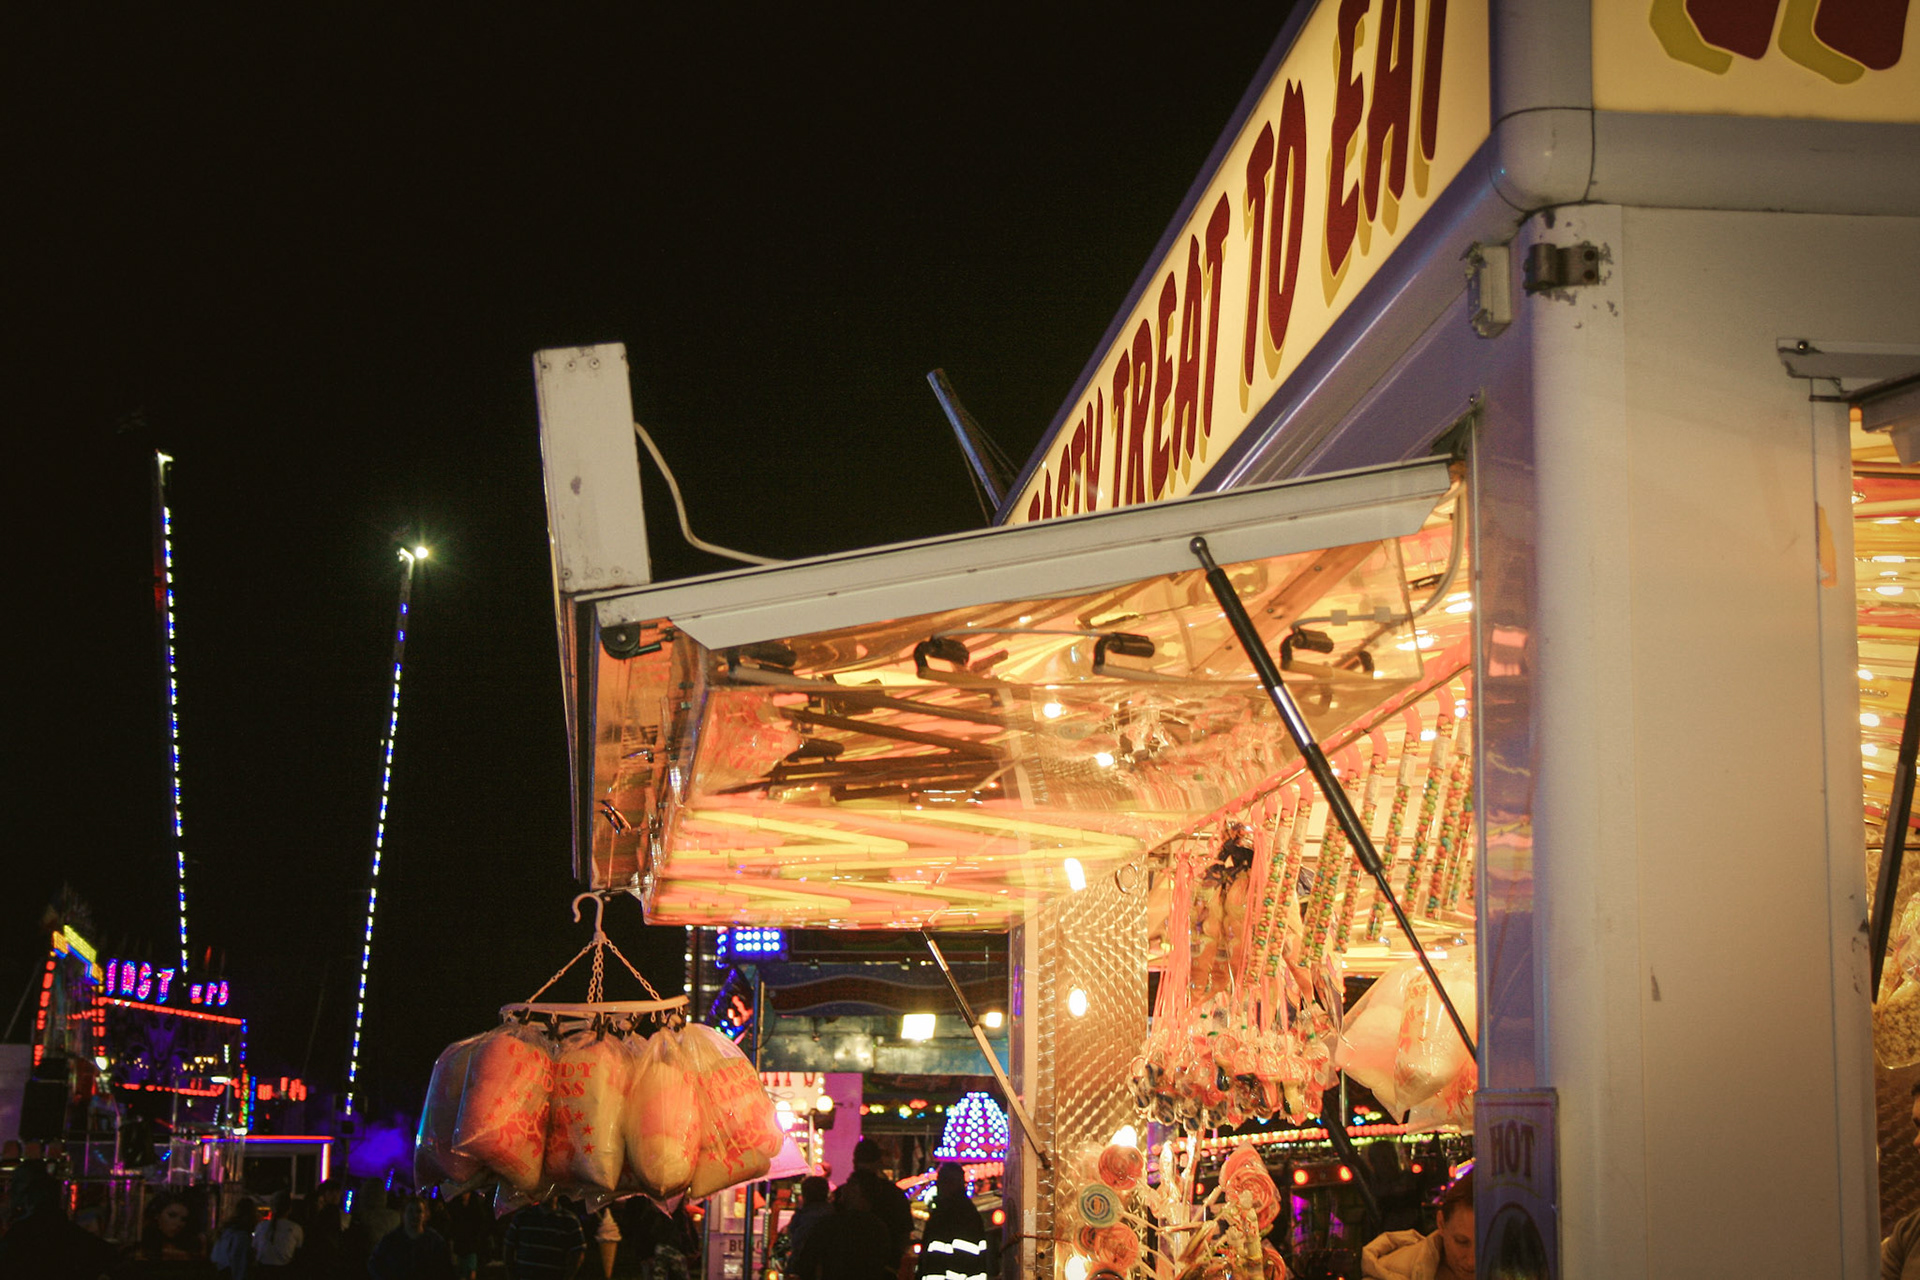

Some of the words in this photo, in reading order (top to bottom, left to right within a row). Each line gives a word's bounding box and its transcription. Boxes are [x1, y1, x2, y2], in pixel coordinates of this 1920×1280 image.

[1111, 191, 1231, 508] TREAT
[1246, 78, 1307, 387] TO
[1489, 1120, 1535, 1178] HOT
